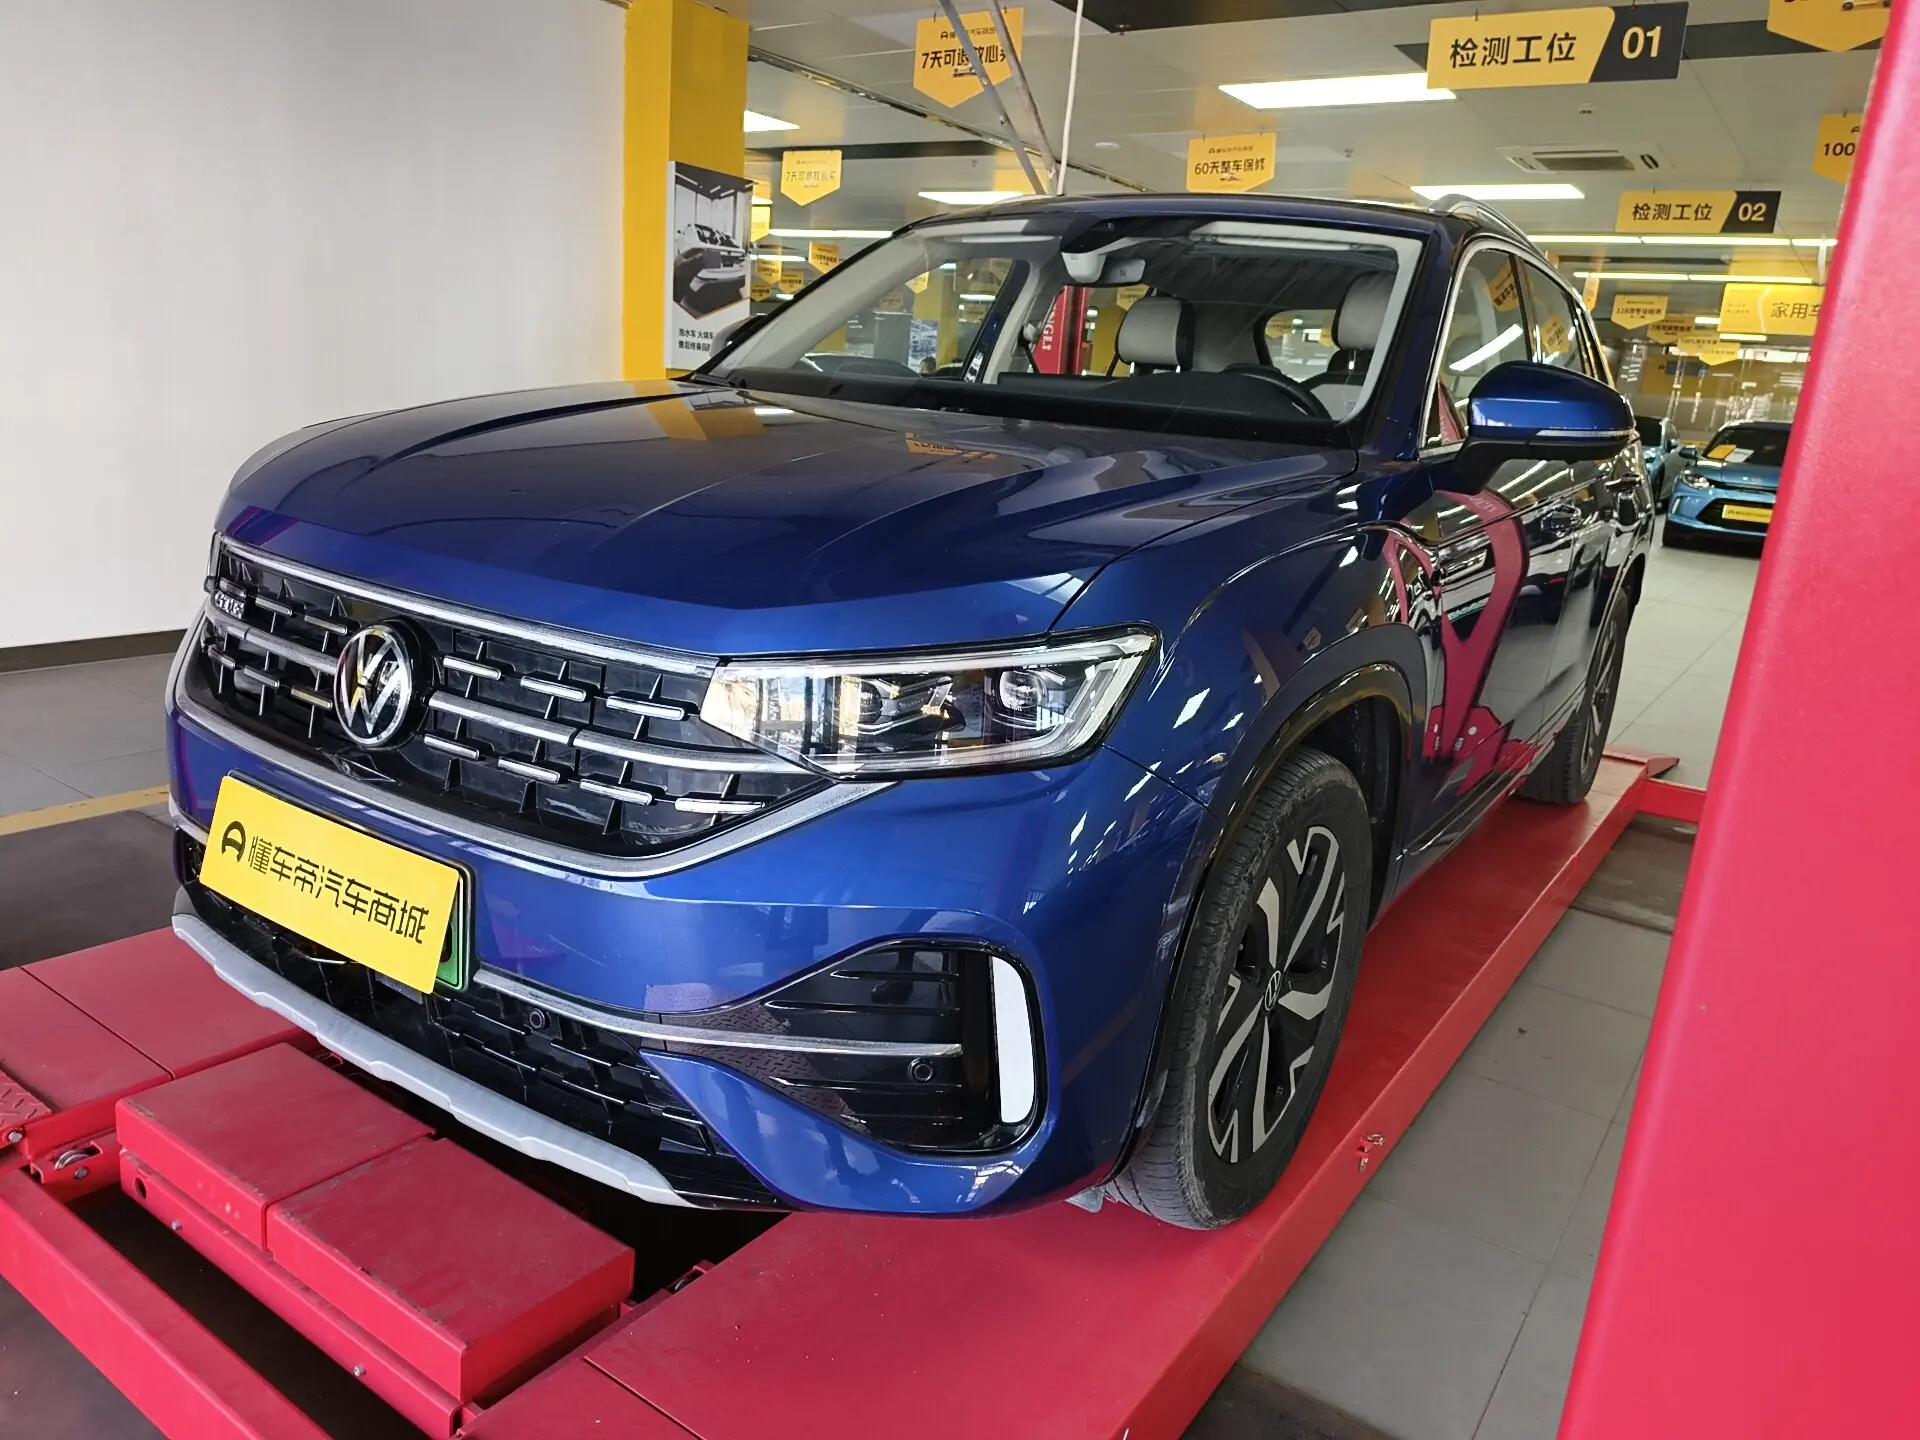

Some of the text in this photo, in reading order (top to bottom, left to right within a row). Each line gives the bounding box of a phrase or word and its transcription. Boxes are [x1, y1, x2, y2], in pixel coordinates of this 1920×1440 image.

[1449, 25, 1662, 69] 检测工位 01
[1632, 202, 1767, 222] 检测工位 02
[248, 835, 430, 945] 懂车帝汽车商城
